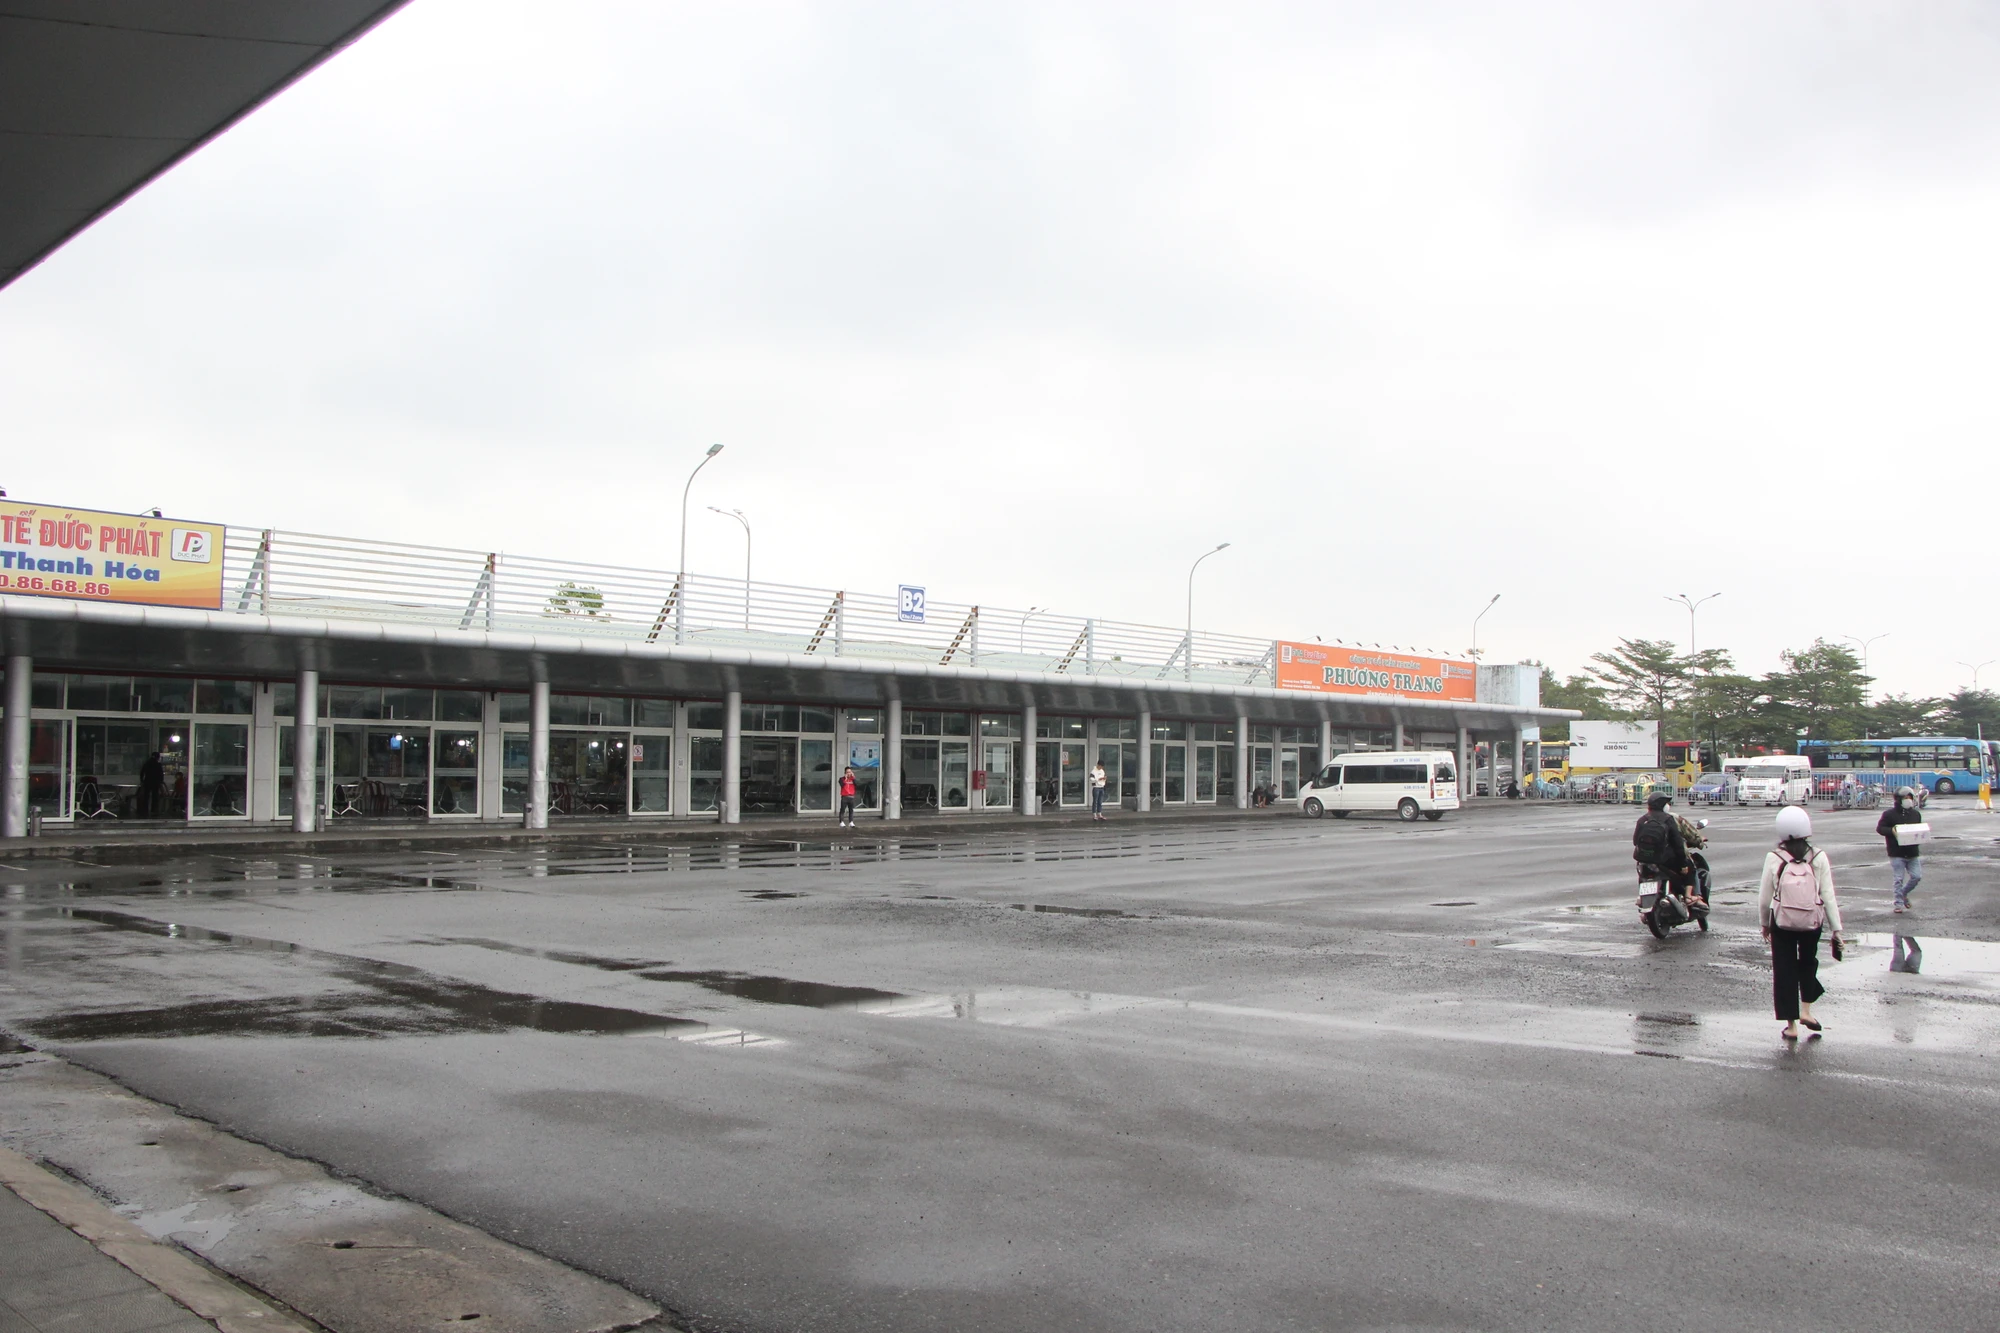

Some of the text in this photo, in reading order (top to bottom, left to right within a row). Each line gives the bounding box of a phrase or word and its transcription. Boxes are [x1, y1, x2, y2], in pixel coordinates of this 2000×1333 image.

[1, 510, 163, 558] TẾ ĐỨC PHÁT
[0, 550, 160, 582] Thanh Hóa
[902, 590, 924, 613] B2
[1323, 665, 1443, 693] PHƯƠNG TRANG
